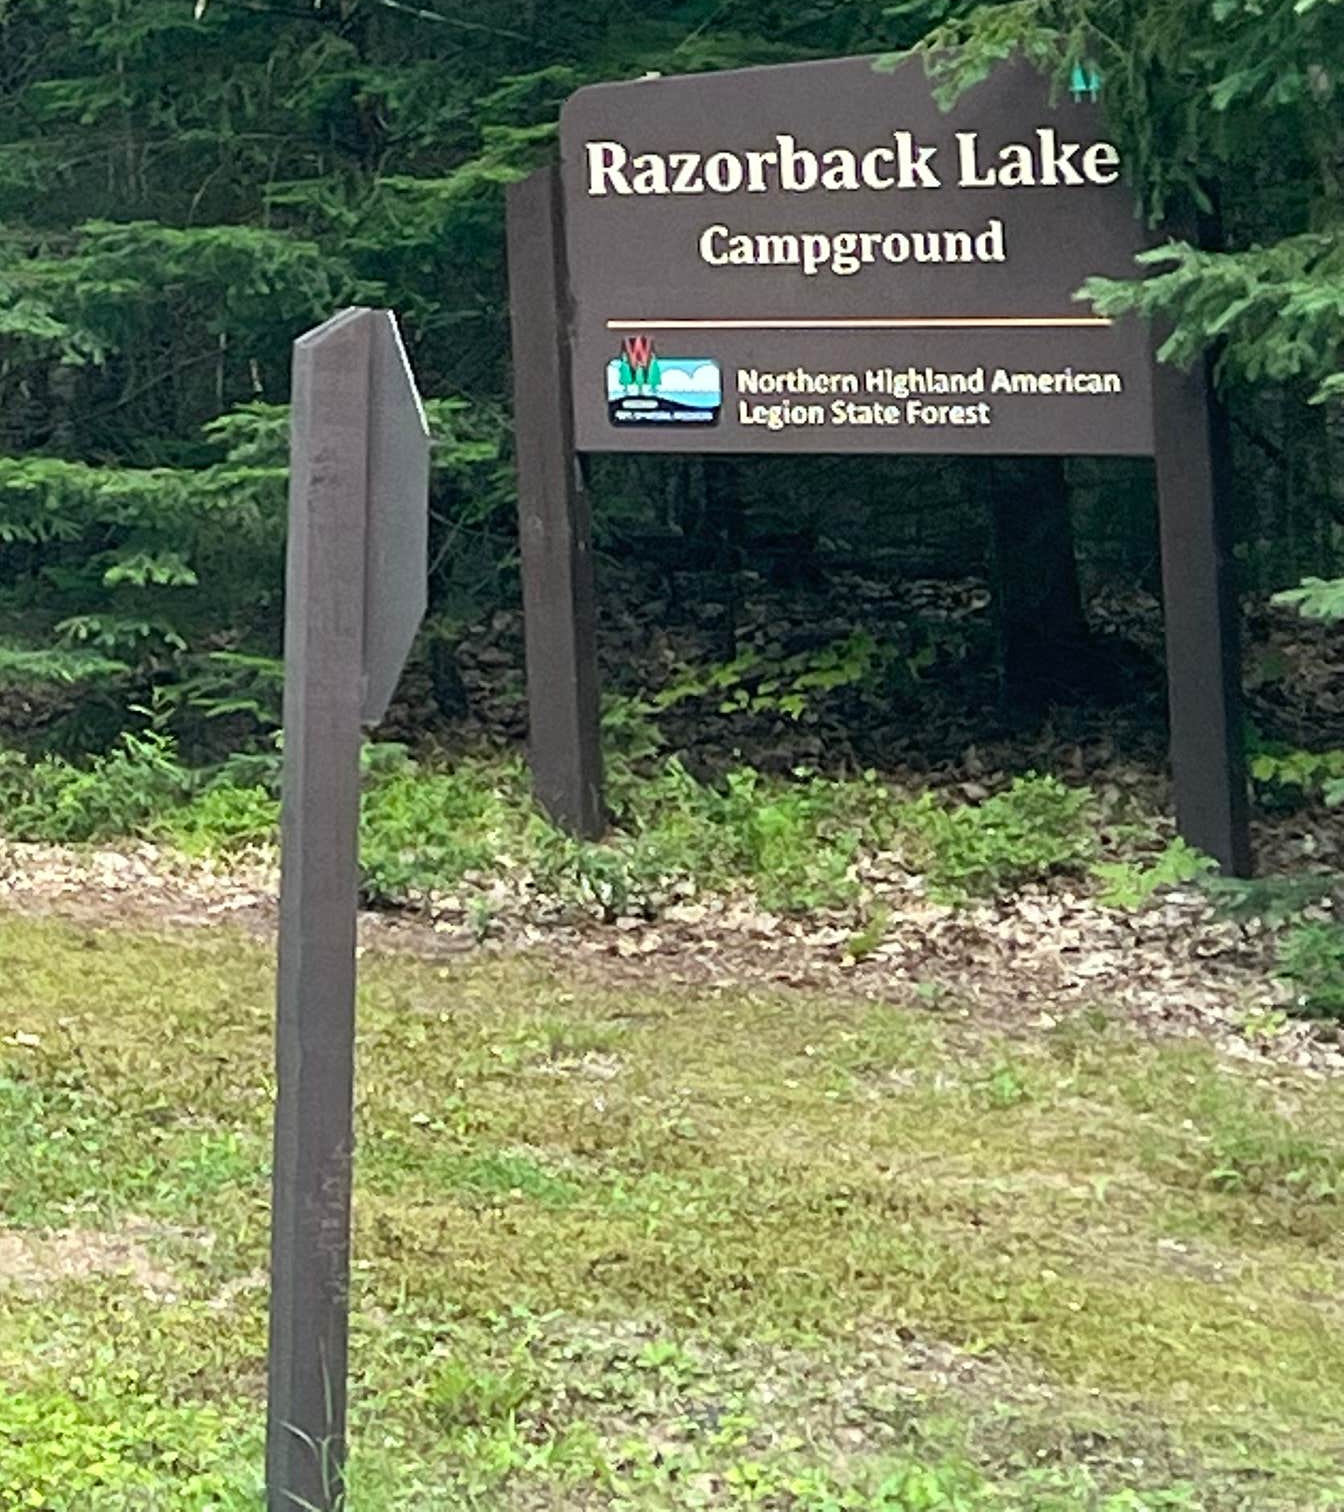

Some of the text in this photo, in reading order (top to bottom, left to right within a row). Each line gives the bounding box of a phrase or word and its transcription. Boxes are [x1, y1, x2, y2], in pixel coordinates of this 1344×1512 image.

[585, 128, 1120, 195] Razorback Lake
[699, 219, 1006, 274] Campground
[737, 368, 1121, 399] Northern Highland American
[738, 399, 991, 429] Legion State Forest
